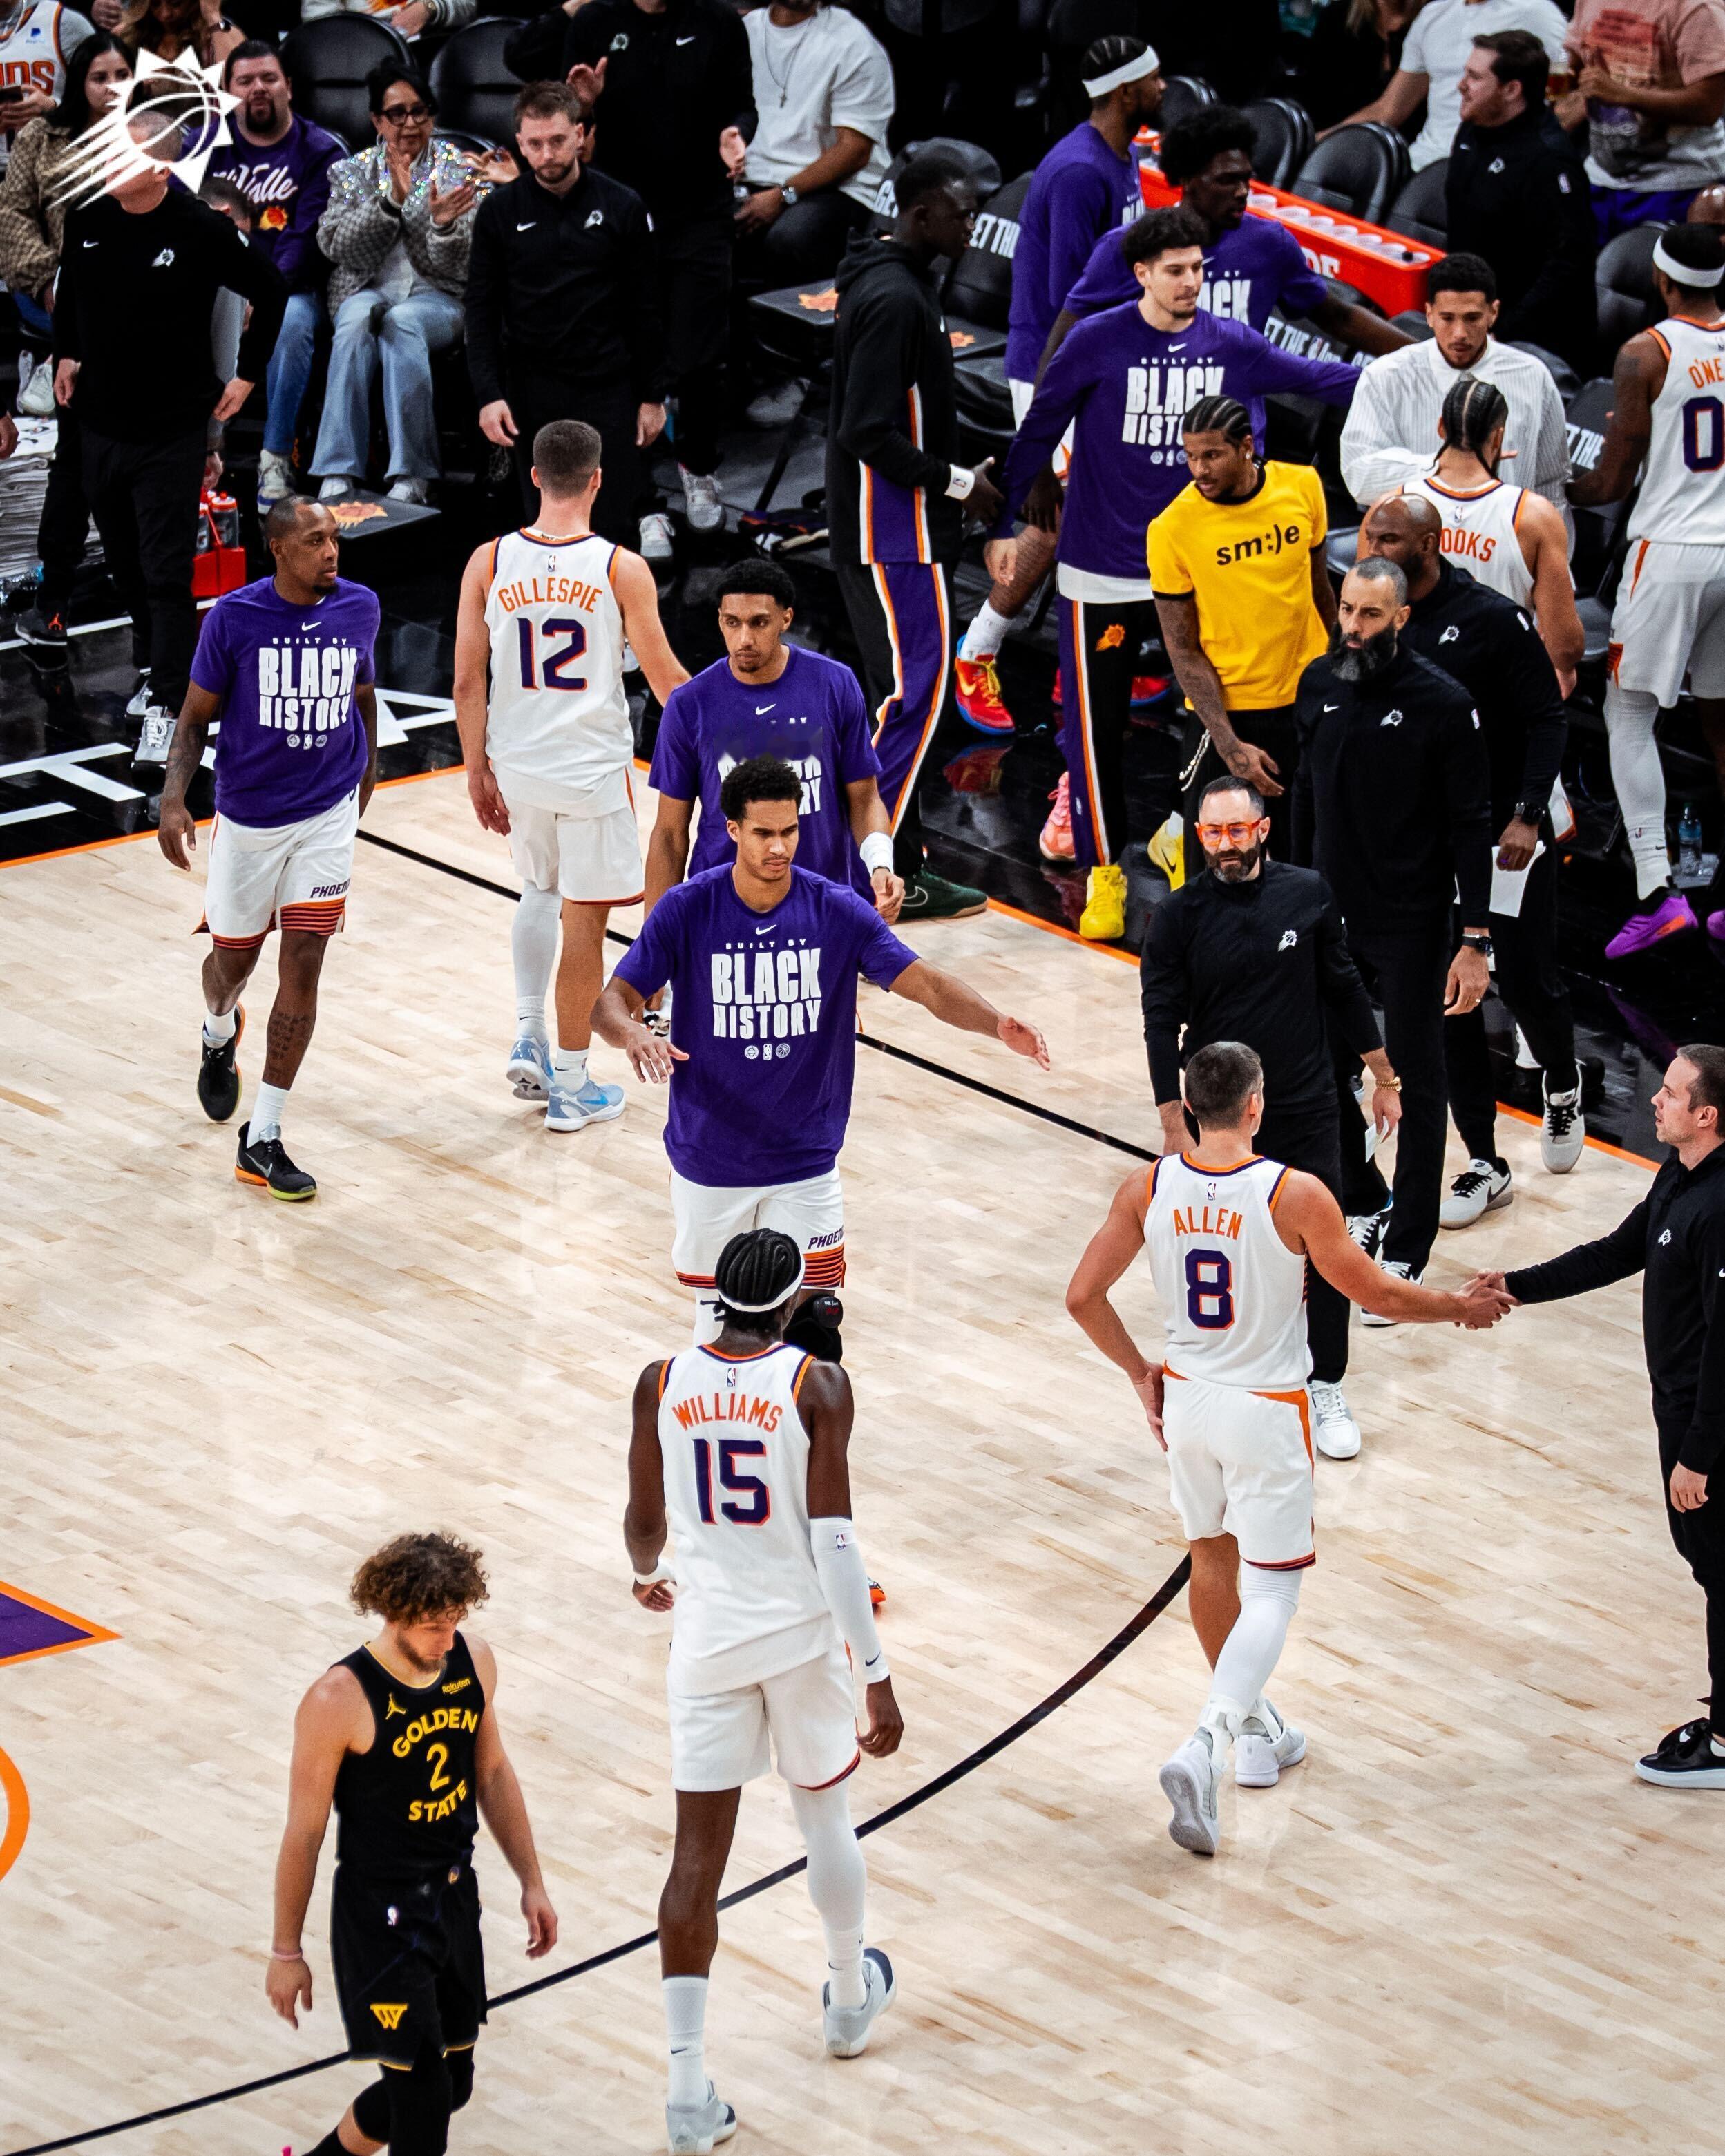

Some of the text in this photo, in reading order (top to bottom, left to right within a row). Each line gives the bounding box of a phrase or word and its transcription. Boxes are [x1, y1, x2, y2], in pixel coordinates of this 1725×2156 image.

[1682, 396, 1725, 473] 0
[1441, 528, 1496, 562] OOKS
[497, 577, 603, 613] GILLESPIE
[332, 637, 347, 645] BY
[516, 618, 587, 691] 12
[258, 647, 358, 698] BLACK
[259, 694, 351, 732] HISTORY
[725, 941, 775, 950] BUILT
[711, 948, 822, 1004] BLACK
[712, 999, 822, 1040] HISTORY
[1173, 1206, 1243, 1241] ALLEN
[1185, 1248, 1235, 1331] 8
[671, 1392, 783, 1433] WILLIAMS
[691, 1438, 771, 1527] 15
[441, 1677, 471, 1695] Rakuten
[392, 1708, 479, 1758] GOLDEN
[426, 1743, 450, 1792] 2
[408, 1779, 468, 1823] STATE
